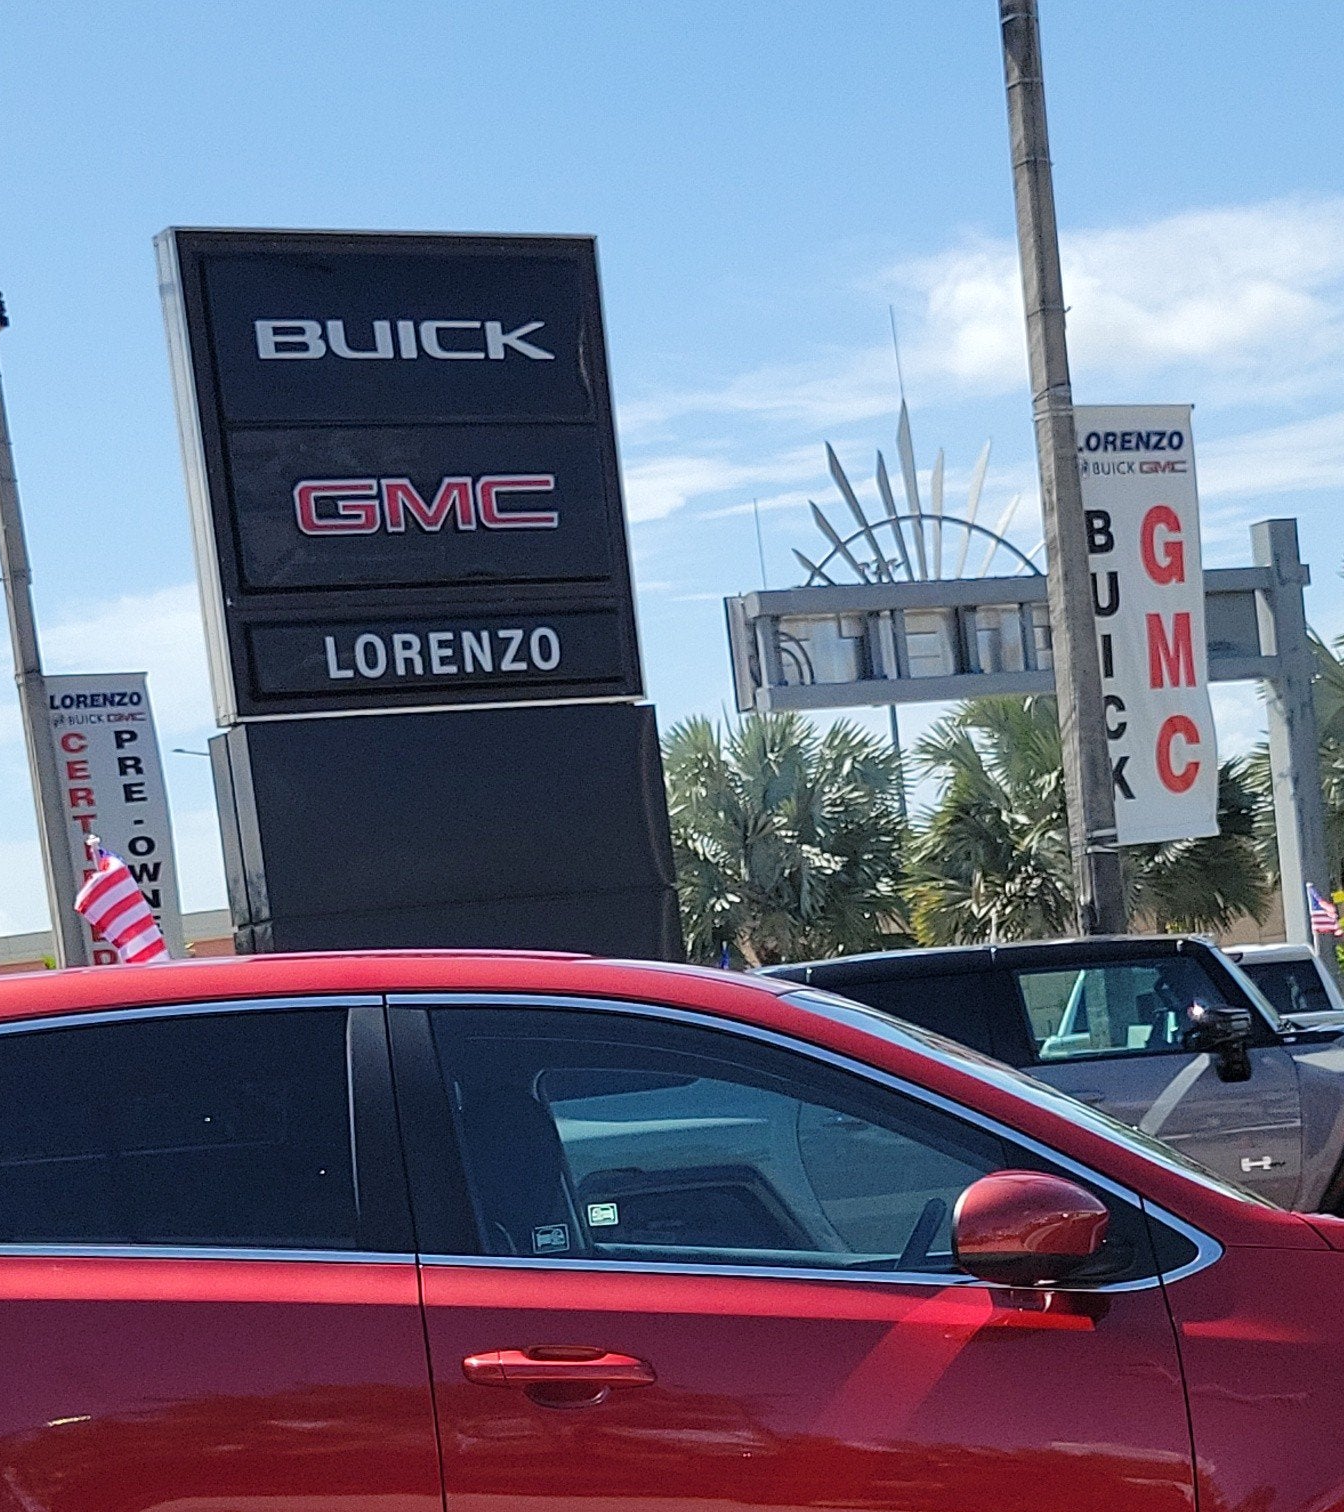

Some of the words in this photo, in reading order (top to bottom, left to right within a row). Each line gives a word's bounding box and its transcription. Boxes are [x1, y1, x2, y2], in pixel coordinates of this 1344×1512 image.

[254, 320, 556, 360] BUICK
[1077, 430, 1184, 452] ORENZO
[1092, 461, 1135, 475] BUICK
[1139, 460, 1187, 474] GMC
[293, 474, 558, 536] GMC
[325, 626, 561, 679] LORENZO
[1140, 505, 1201, 794] GMC
[49, 691, 143, 709] LORENZO
